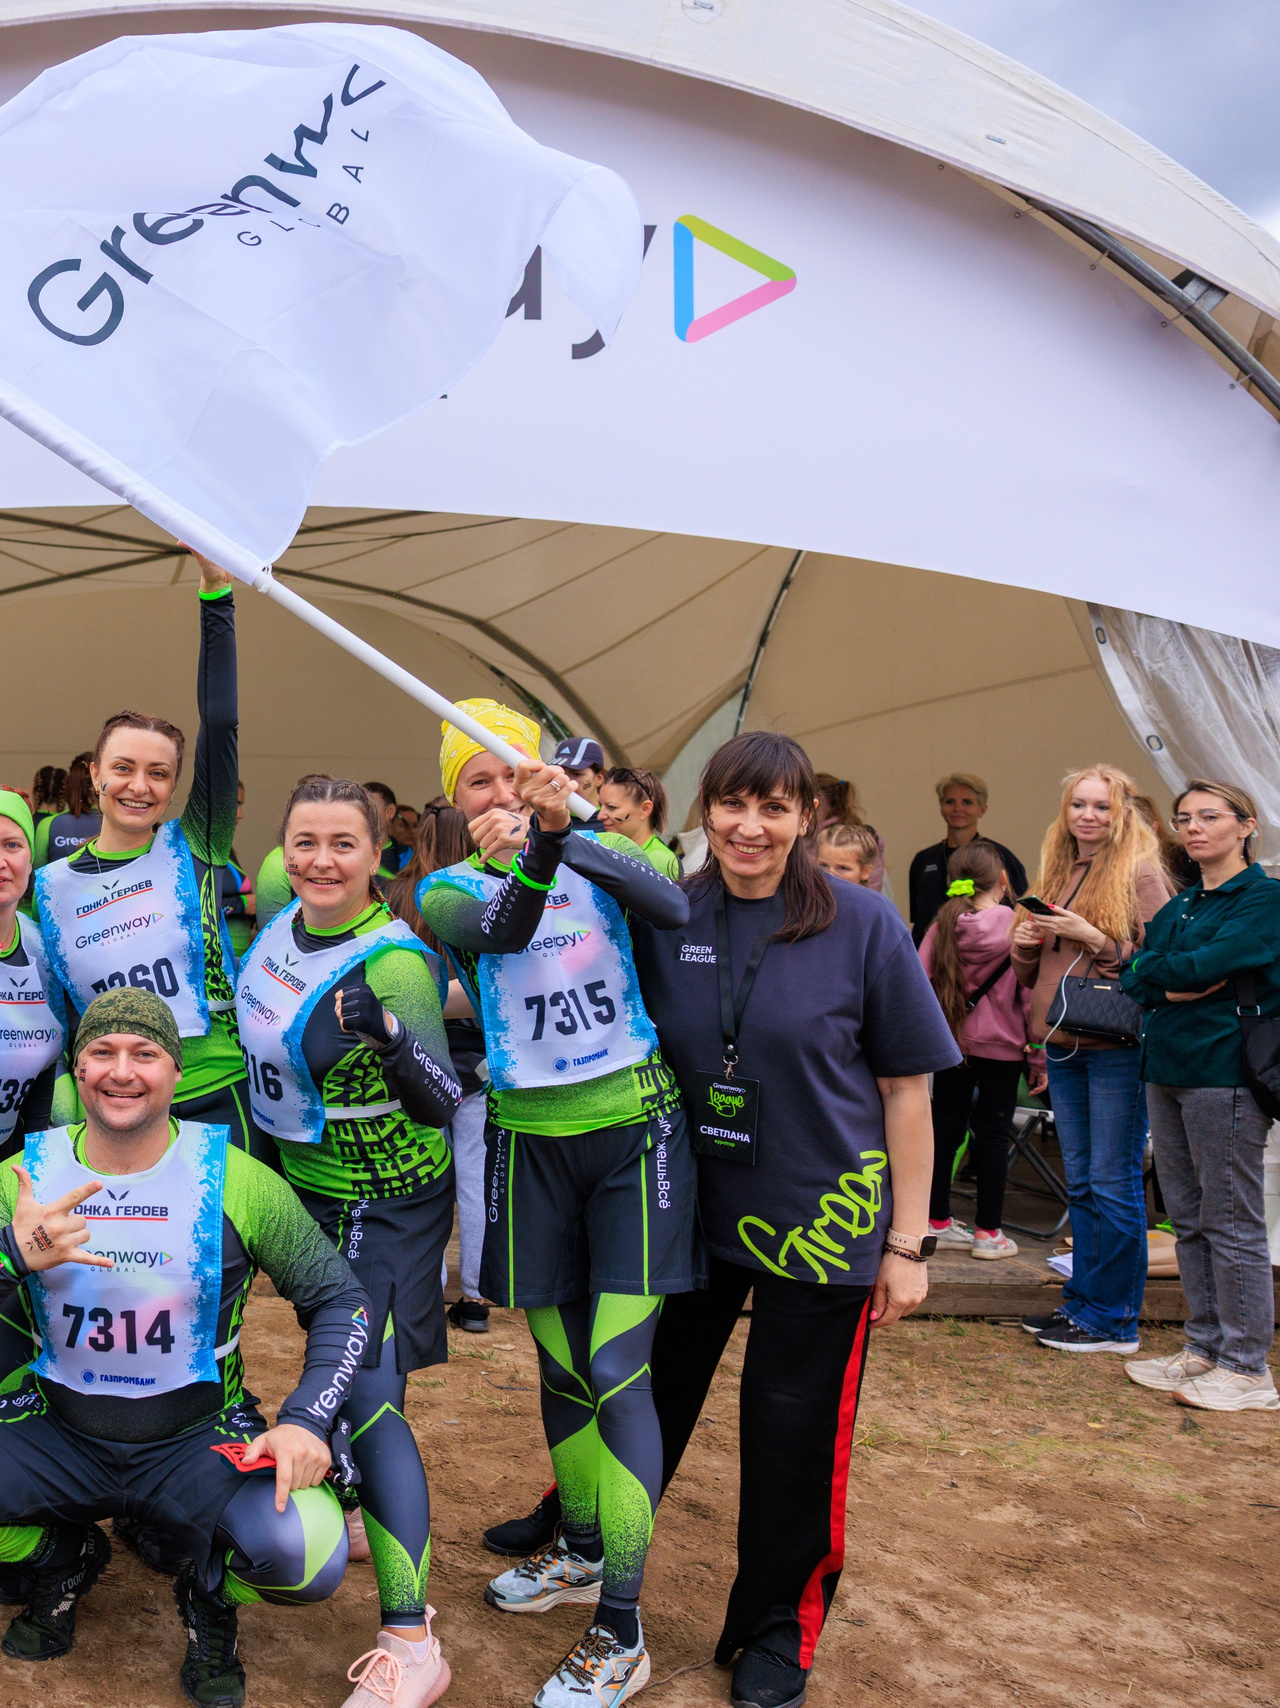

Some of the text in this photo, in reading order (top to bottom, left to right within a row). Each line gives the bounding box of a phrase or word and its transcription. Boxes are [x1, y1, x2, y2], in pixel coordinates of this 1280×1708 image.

[237, 128, 369, 246] GLBAL
[28, 63, 386, 346] Greenw
[54, 836, 87, 848] Gree
[613, 853, 662, 882] GLOBAL
[77, 880, 153, 916] ГОНКА ГЕРОЕВ
[501, 882, 523, 924] GLOBAL
[76, 915, 152, 949] Greenway
[101, 932, 136, 946] GLOBAL
[679, 953, 717, 964] LEAGUE
[681, 944, 712, 955] GREEN
[279, 969, 306, 991] ГЕРОЕВ
[18, 991, 43, 1001] ГЕРО
[241, 986, 278, 1025] Greenway
[524, 980, 616, 1041] 7315
[241, 1045, 283, 1101] 316
[424, 1078, 448, 1106] GLOBAL
[707, 1086, 745, 1117] League
[713, 1082, 741, 1094] Greenway
[700, 1125, 750, 1143] СВЕТЛАНА
[74, 1205, 169, 1217] ОНКА ГЕРОЕВ
[737, 1150, 887, 1284] Green
[32, 1231, 45, 1251] ГОНКА
[38, 1225, 55, 1249] ГЕРОЕВ
[61, 1303, 175, 1355] 7314
[100, 1373, 156, 1386] ГАЗПРОМБАНК
